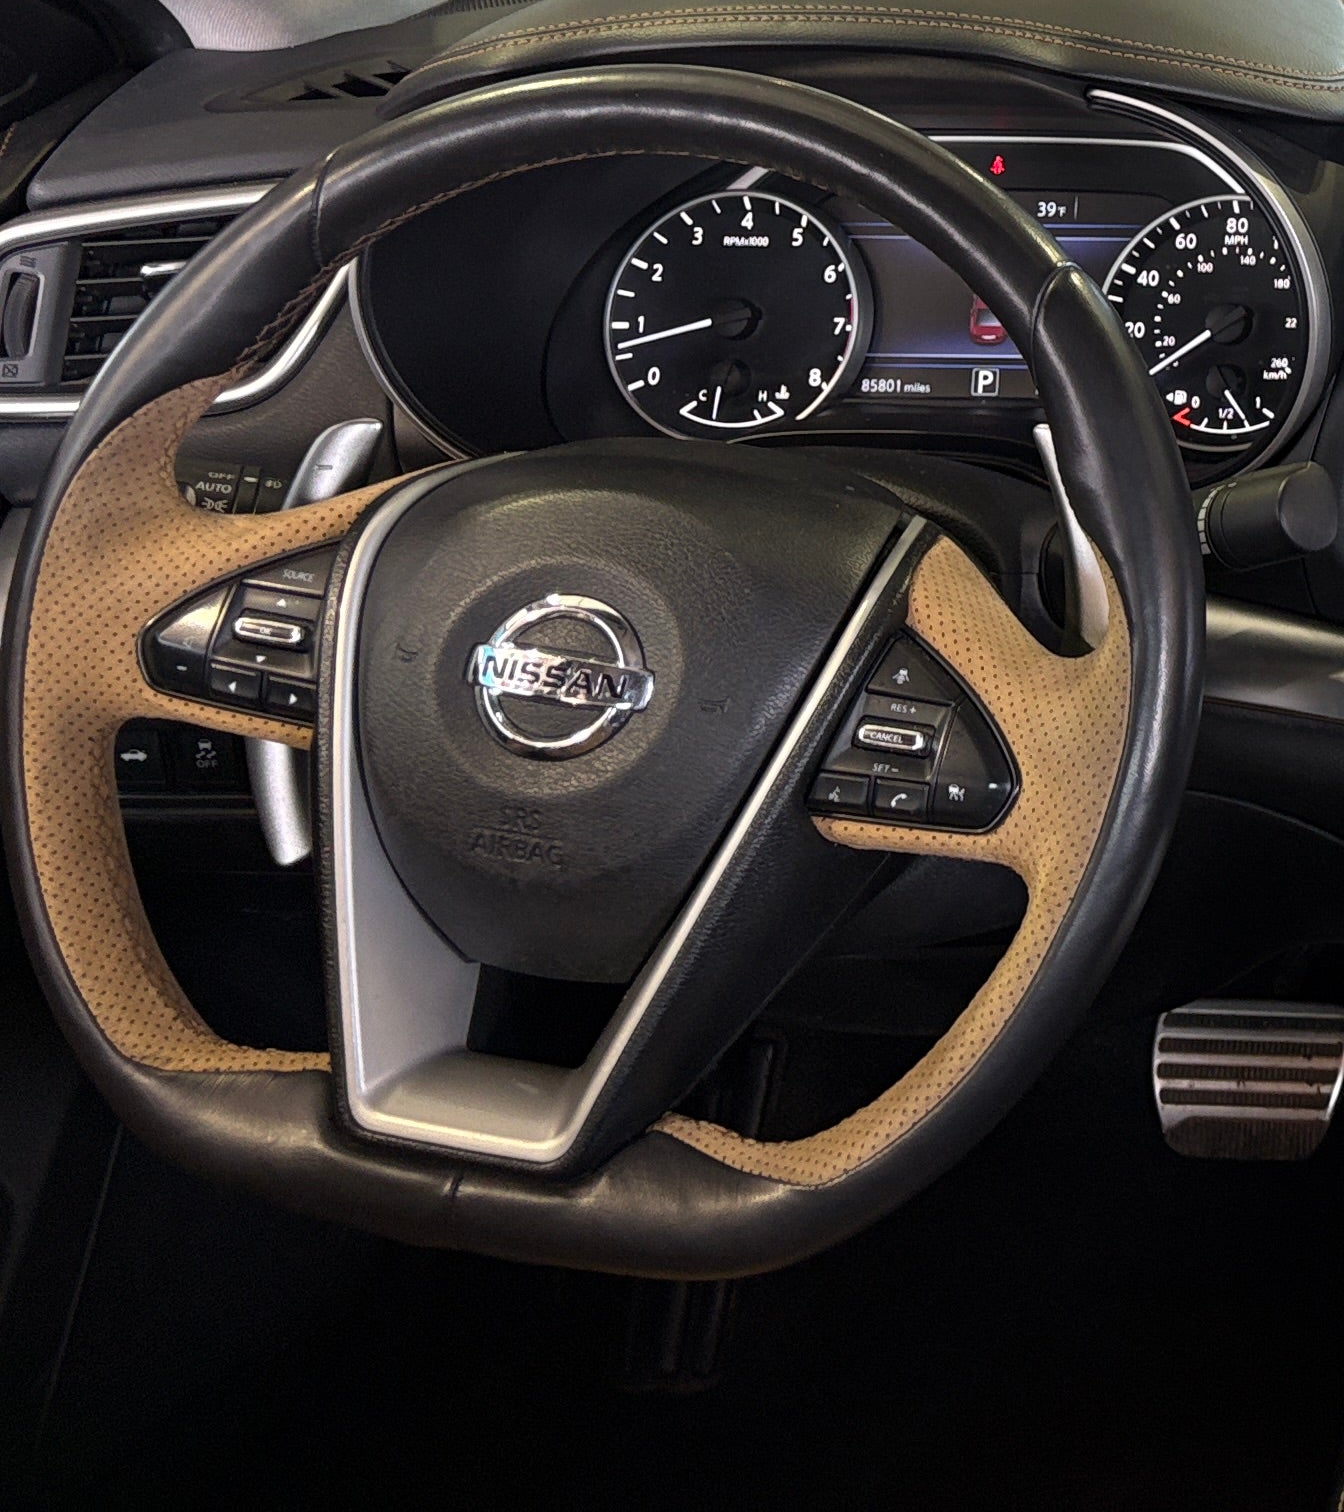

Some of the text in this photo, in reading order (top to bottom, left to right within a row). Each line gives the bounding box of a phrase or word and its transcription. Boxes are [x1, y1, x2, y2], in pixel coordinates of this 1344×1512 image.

[741, 212, 754, 230] 4
[1226, 217, 1249, 233] 80
[692, 227, 704, 246] 3
[792, 228, 804, 247] 5
[1175, 233, 1197, 250] 60
[1224, 235, 1249, 246] MPH
[1197, 262, 1213, 273] 100
[1240, 255, 1256, 266] 140
[651, 263, 664, 282] 2
[823, 265, 836, 284] 6
[1137, 270, 1160, 287] 40
[1167, 294, 1181, 305] 60
[637, 316, 645, 333] 1
[833, 317, 845, 335] 7
[1163, 336, 1176, 346] 20
[1271, 357, 1289, 368] 260
[648, 366, 660, 385] 0
[808, 368, 822, 386] 8
[977, 370, 994, 394] P
[1263, 370, 1287, 381] km/h
[861, 378, 931, 393] 85801 miles
[698, 390, 708, 401] C
[758, 390, 768, 402] H
[1191, 397, 1200, 408] 0
[1218, 408, 1234, 420] 1/2
[195, 481, 232, 494] AUTO
[482, 655, 627, 699] NISSAN
[890, 703, 908, 713] RES
[869, 732, 904, 744] CANCEL
[196, 759, 219, 769] OFF
